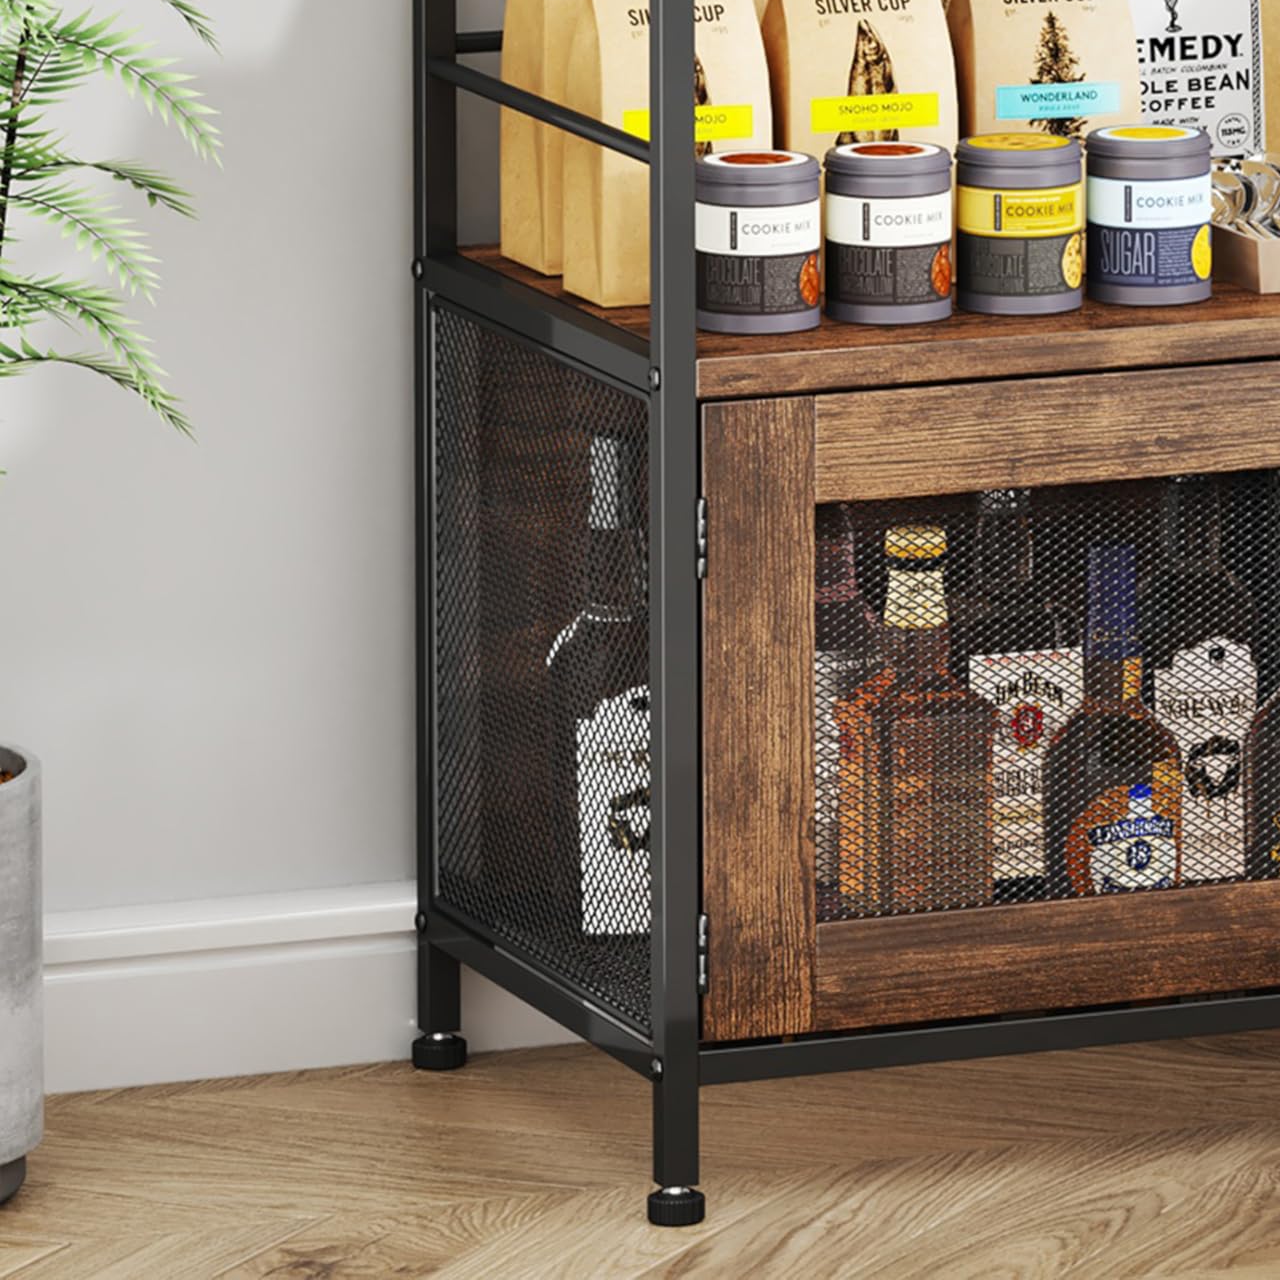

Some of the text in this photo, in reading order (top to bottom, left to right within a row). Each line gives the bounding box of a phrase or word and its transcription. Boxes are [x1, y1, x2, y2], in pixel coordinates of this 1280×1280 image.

[1188, 68, 1250, 91] BEAN
[1020, 90, 1098, 103] WONDERLAND
[838, 101, 913, 115] SNOHO MOJO
[1136, 195, 1185, 208] COOKIE
[1006, 204, 1055, 217] COOKIE
[874, 213, 923, 227] COOKIE
[741, 222, 791, 236] COOKIE
[1101, 229, 1156, 275] SUGAR
